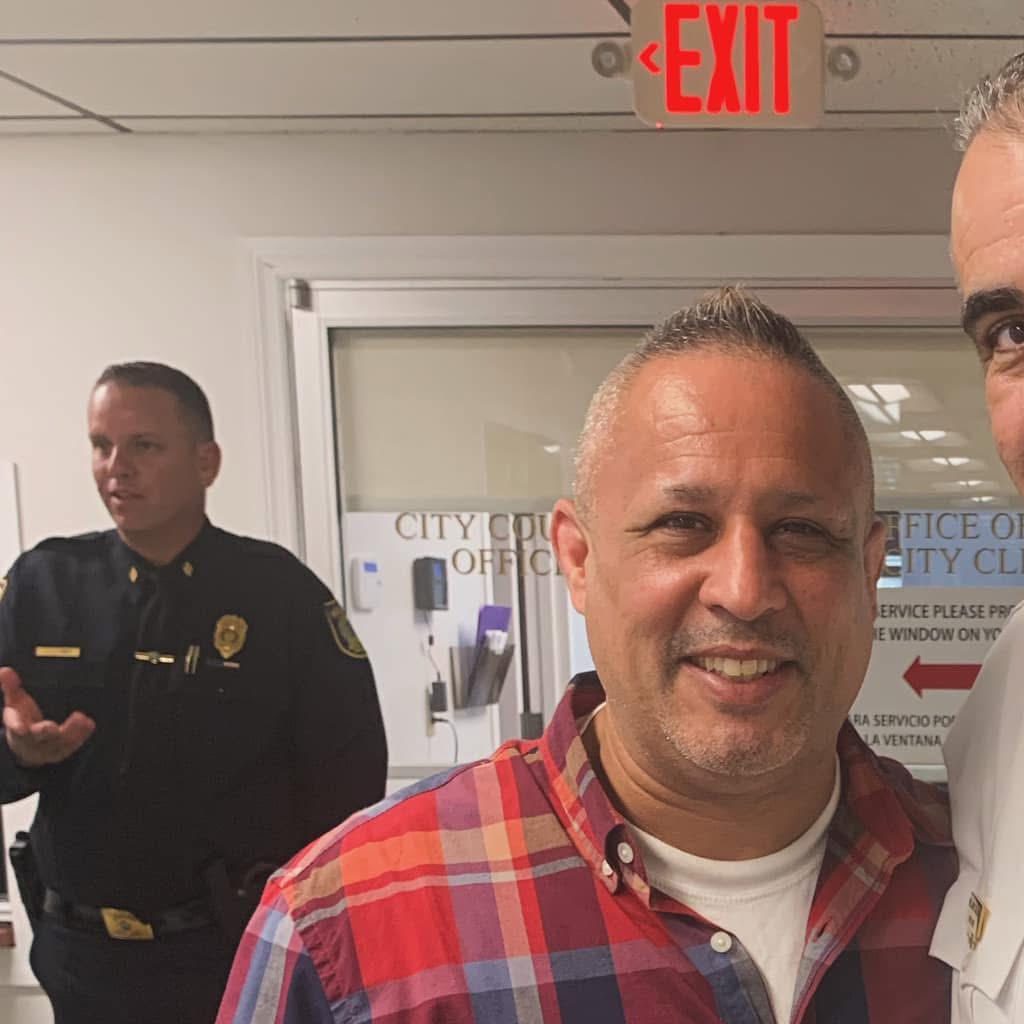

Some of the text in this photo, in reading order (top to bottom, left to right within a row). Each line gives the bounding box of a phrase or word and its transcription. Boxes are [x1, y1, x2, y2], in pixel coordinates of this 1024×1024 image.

[664, 3, 799, 114] EXIT
[394, 513, 476, 540] CITY
[878, 604, 929, 619] ERVICE
[933, 604, 985, 619] PLEASE
[888, 628, 955, 641] WINDOW
[958, 627, 980, 641] ON
[872, 714, 931, 728] SERVICIO
[933, 714, 956, 728] PO
[884, 733, 942, 747] VENTANA
